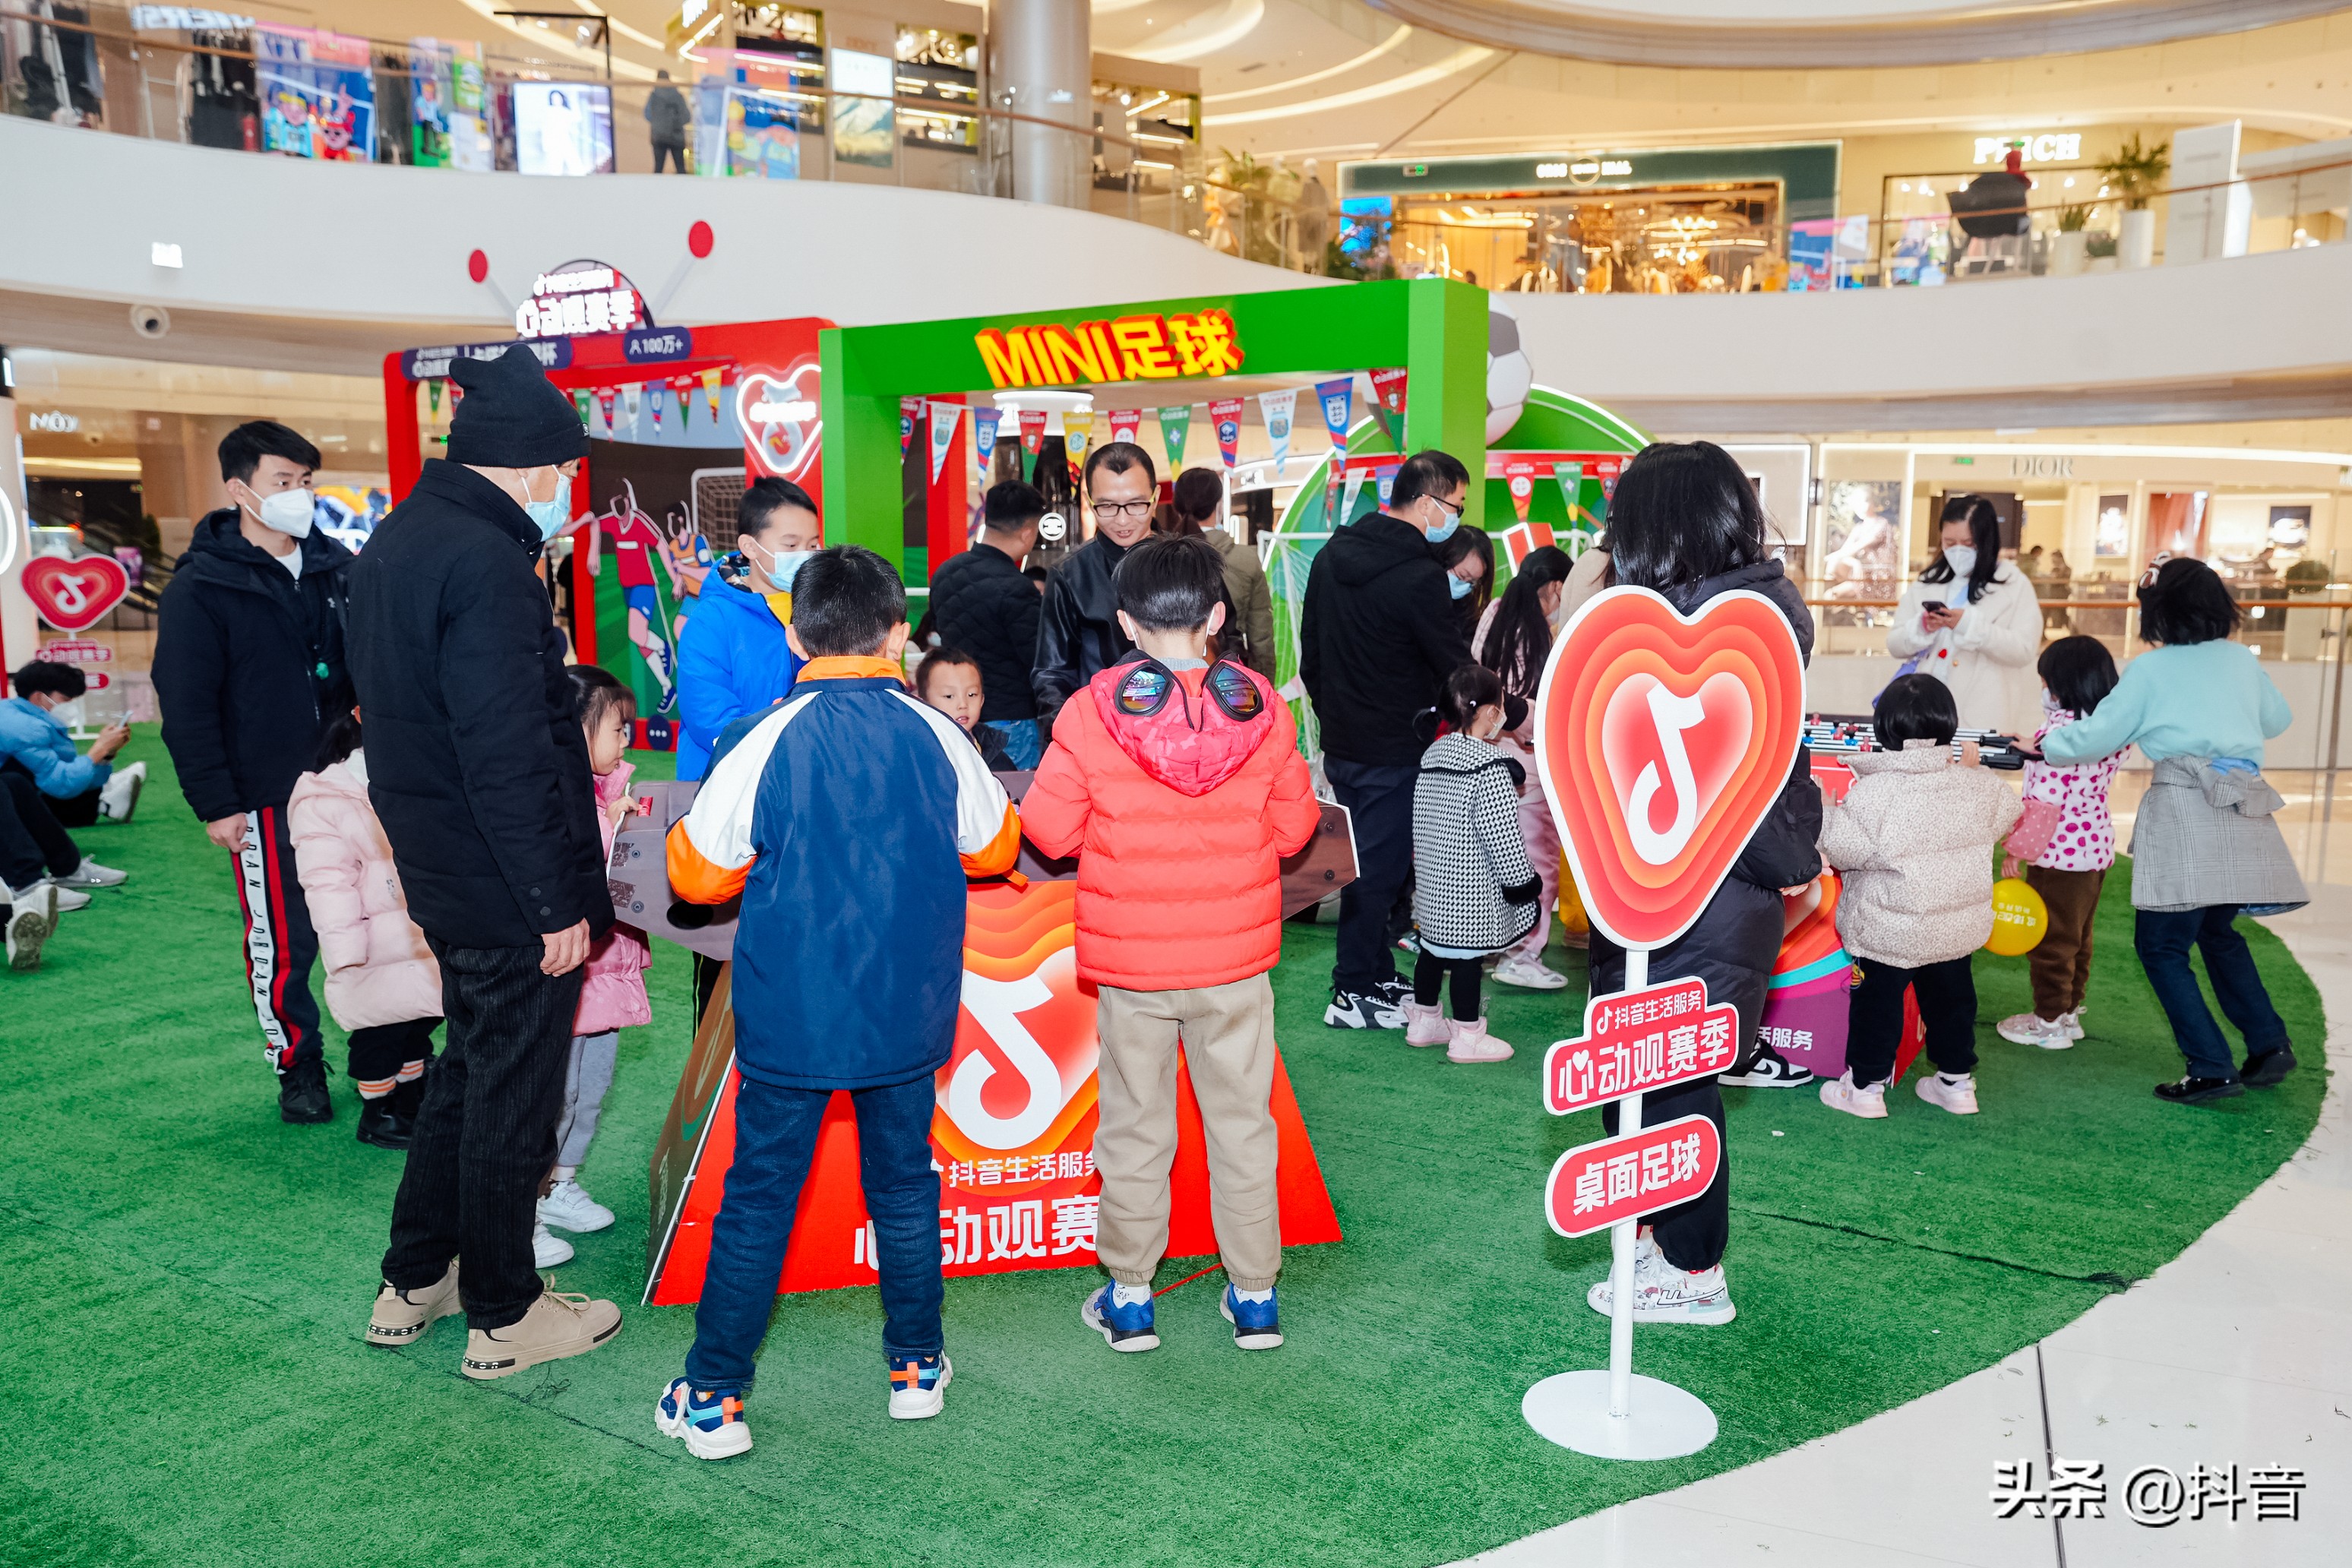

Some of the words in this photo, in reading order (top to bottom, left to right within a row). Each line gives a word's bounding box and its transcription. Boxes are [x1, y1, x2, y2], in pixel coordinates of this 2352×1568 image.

[975, 308, 1245, 388] MINI足球
[2009, 456, 2074, 479] DIOR
[1615, 989, 1702, 1029] 抖音生活服务
[1558, 1016, 1730, 1103] 心动观赛季
[1573, 1132, 1701, 1216] 桌面足球
